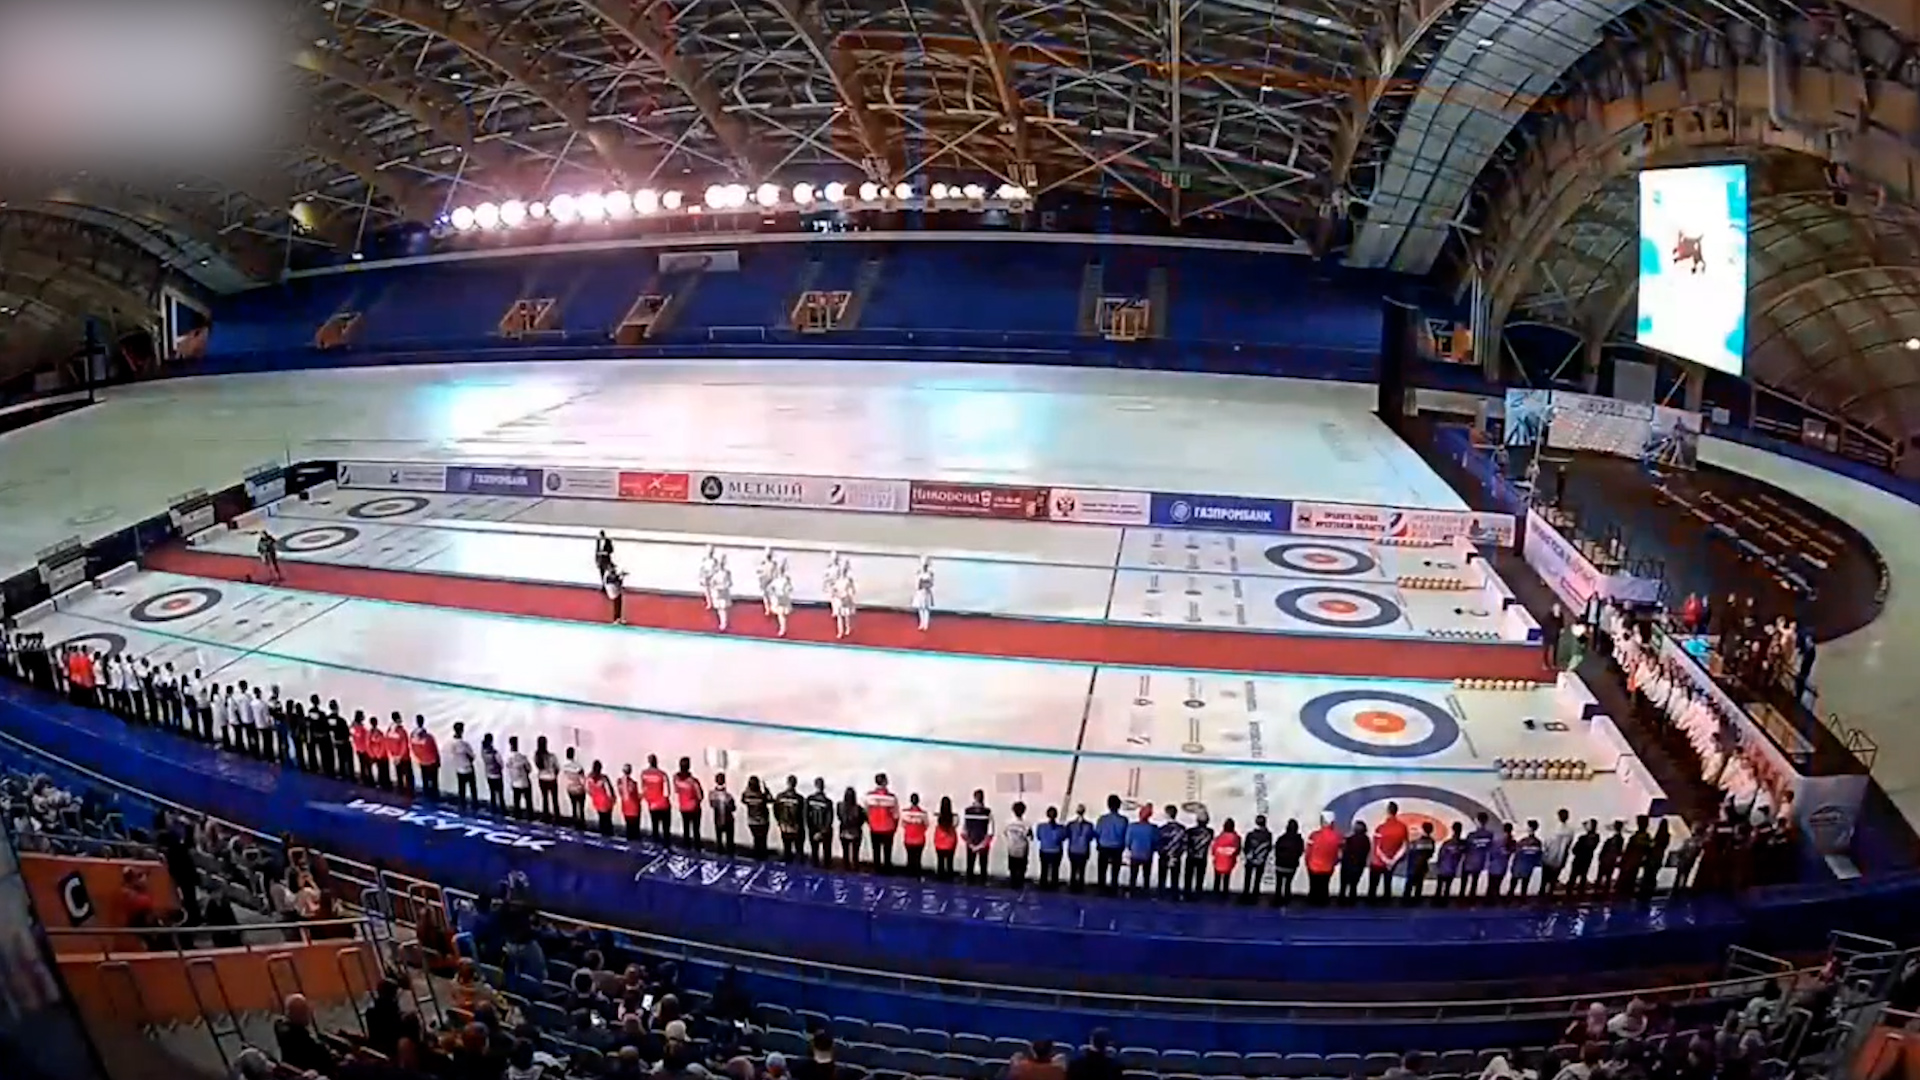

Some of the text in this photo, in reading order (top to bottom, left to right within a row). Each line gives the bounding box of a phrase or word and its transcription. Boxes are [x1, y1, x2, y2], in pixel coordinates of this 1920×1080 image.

[728, 481, 803, 497] МЕТКИЙ
[1193, 505, 1273, 523] ГАЗПРОМБАНК
[347, 798, 556, 852] ИРКУТСК
